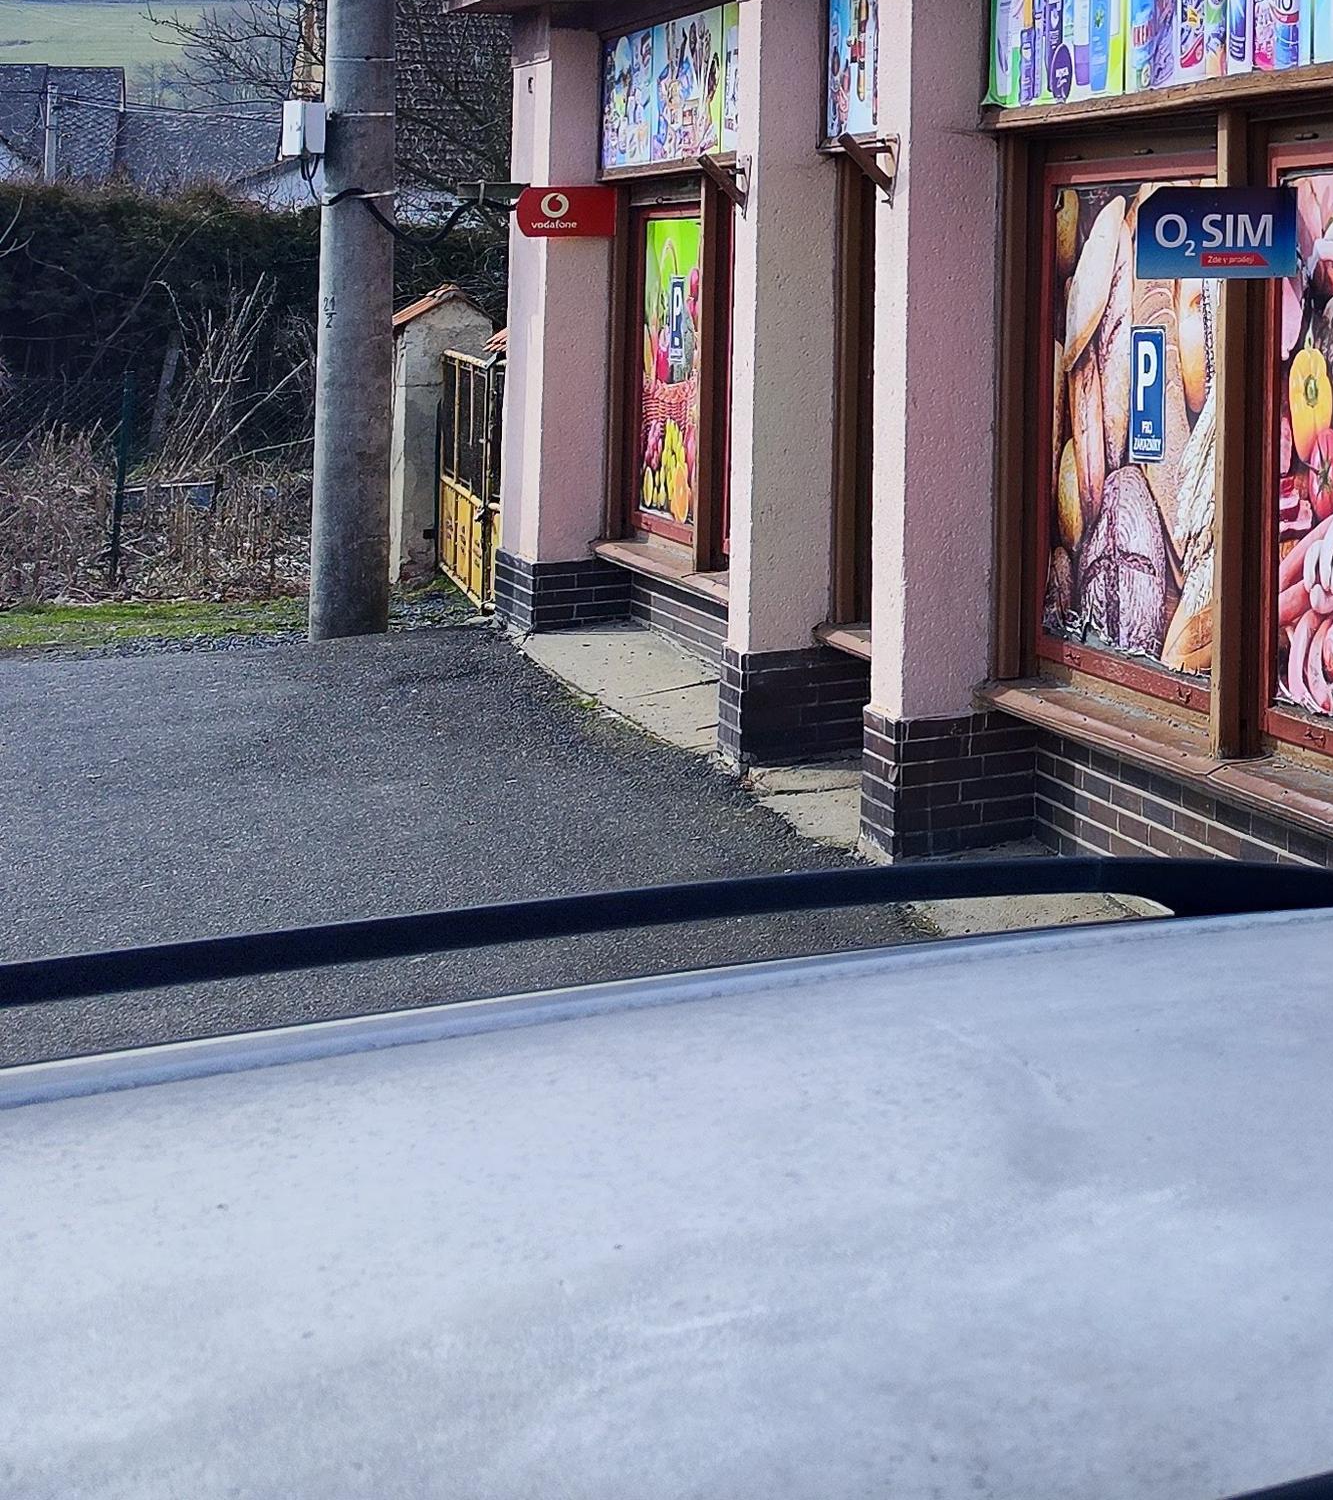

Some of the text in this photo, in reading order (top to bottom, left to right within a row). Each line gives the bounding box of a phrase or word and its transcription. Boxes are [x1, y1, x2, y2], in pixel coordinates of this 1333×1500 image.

[531, 219, 578, 229] vodafone
[1202, 214, 1274, 248] SIM
[673, 286, 682, 332] P
[1137, 340, 1157, 411] P
